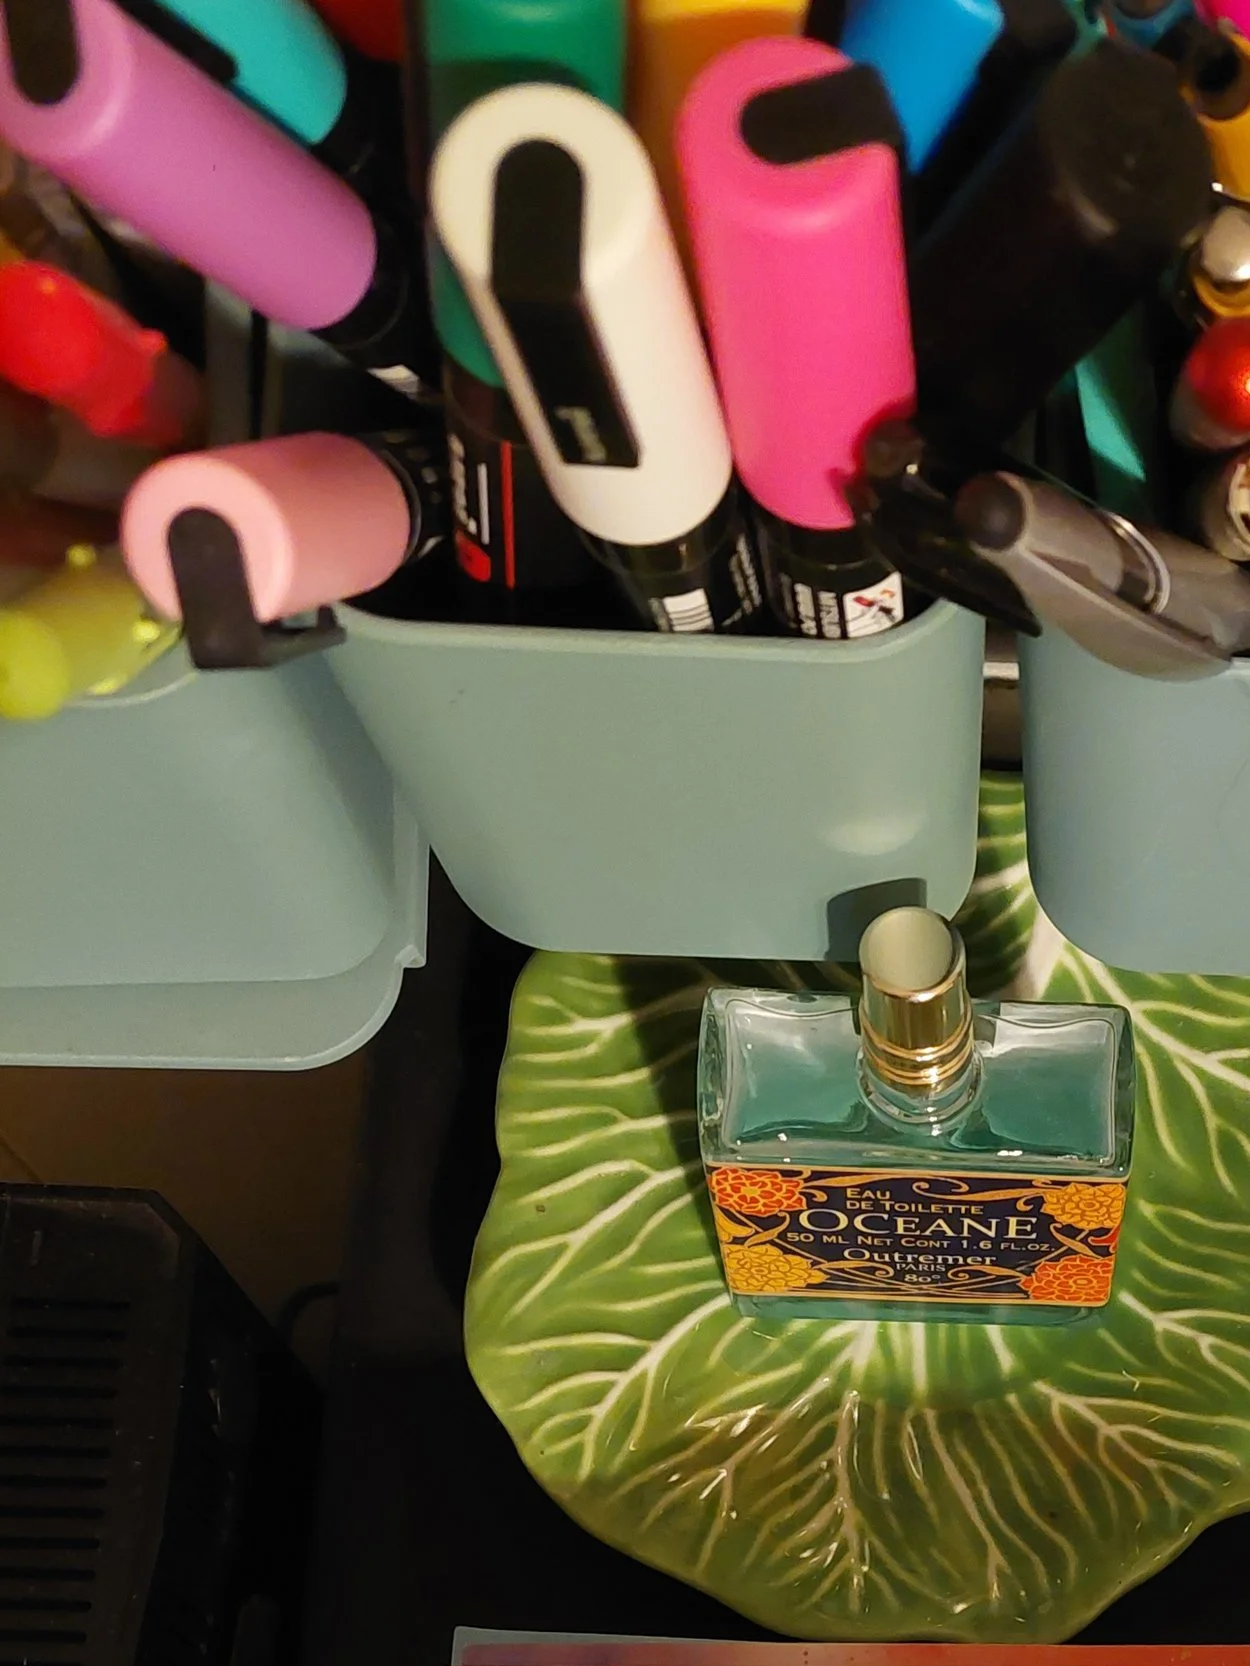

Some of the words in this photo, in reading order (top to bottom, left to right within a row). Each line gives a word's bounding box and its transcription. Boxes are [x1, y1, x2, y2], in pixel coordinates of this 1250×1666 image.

[846, 1188, 890, 1200] EAU
[846, 1200, 874, 1210] DE
[883, 1201, 984, 1215] TOILETTE
[799, 1208, 1037, 1239] OCEANE
[787, 1232, 815, 1243] 50
[823, 1234, 849, 1245] ML
[857, 1235, 893, 1247] NET
[901, 1237, 950, 1249] CONT
[961, 1239, 992, 1250] 1.6
[843, 1248, 996, 1266] Outremer
[896, 1263, 946, 1272] PARIS
